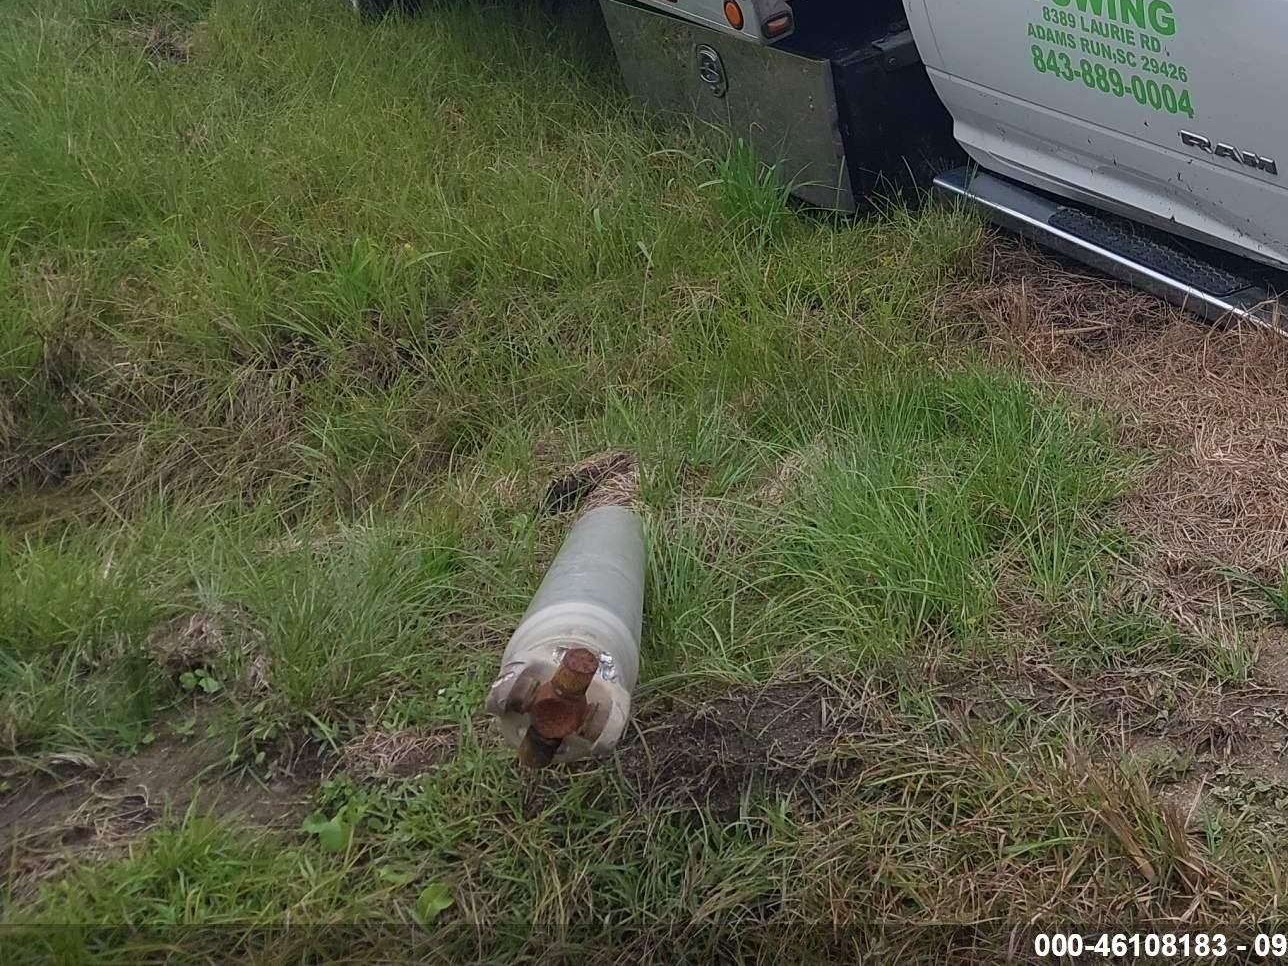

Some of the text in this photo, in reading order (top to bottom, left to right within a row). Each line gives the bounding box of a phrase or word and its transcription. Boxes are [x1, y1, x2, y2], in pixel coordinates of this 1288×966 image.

[1042, 6, 1076, 29] 8389
[1080, 16, 1136, 46] LAURIE
[1027, 23, 1077, 49] ADAMS
[1140, 55, 1188, 83] 29426
[1031, 44, 1195, 119] 843-889-0004
[1179, 129, 1279, 176] RAM
